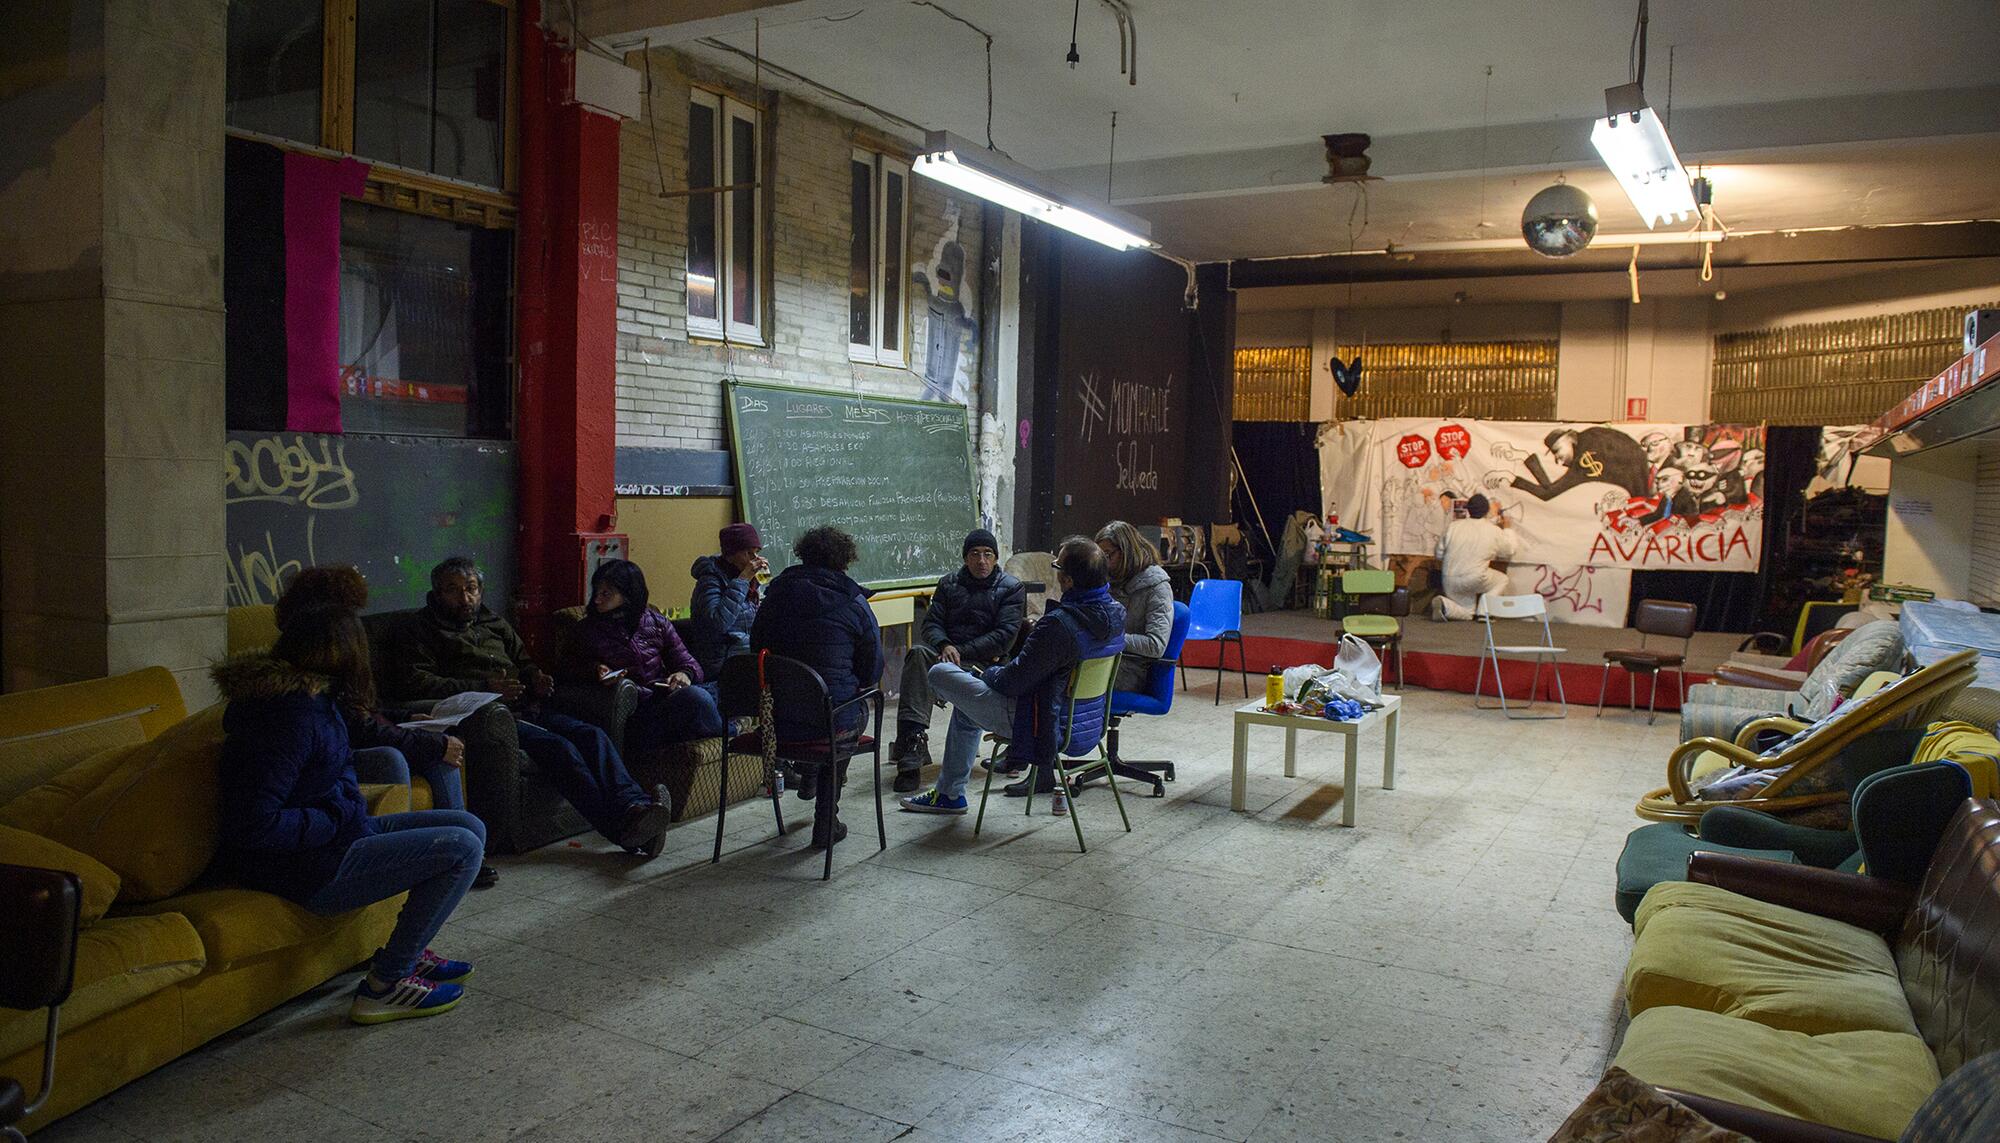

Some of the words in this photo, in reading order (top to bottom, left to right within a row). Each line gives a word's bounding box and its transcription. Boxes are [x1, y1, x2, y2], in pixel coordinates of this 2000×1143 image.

[1440, 431, 1465, 443] STOP
[1401, 440, 1425, 453] STOP
[1589, 525, 1752, 565] AVARICIA
